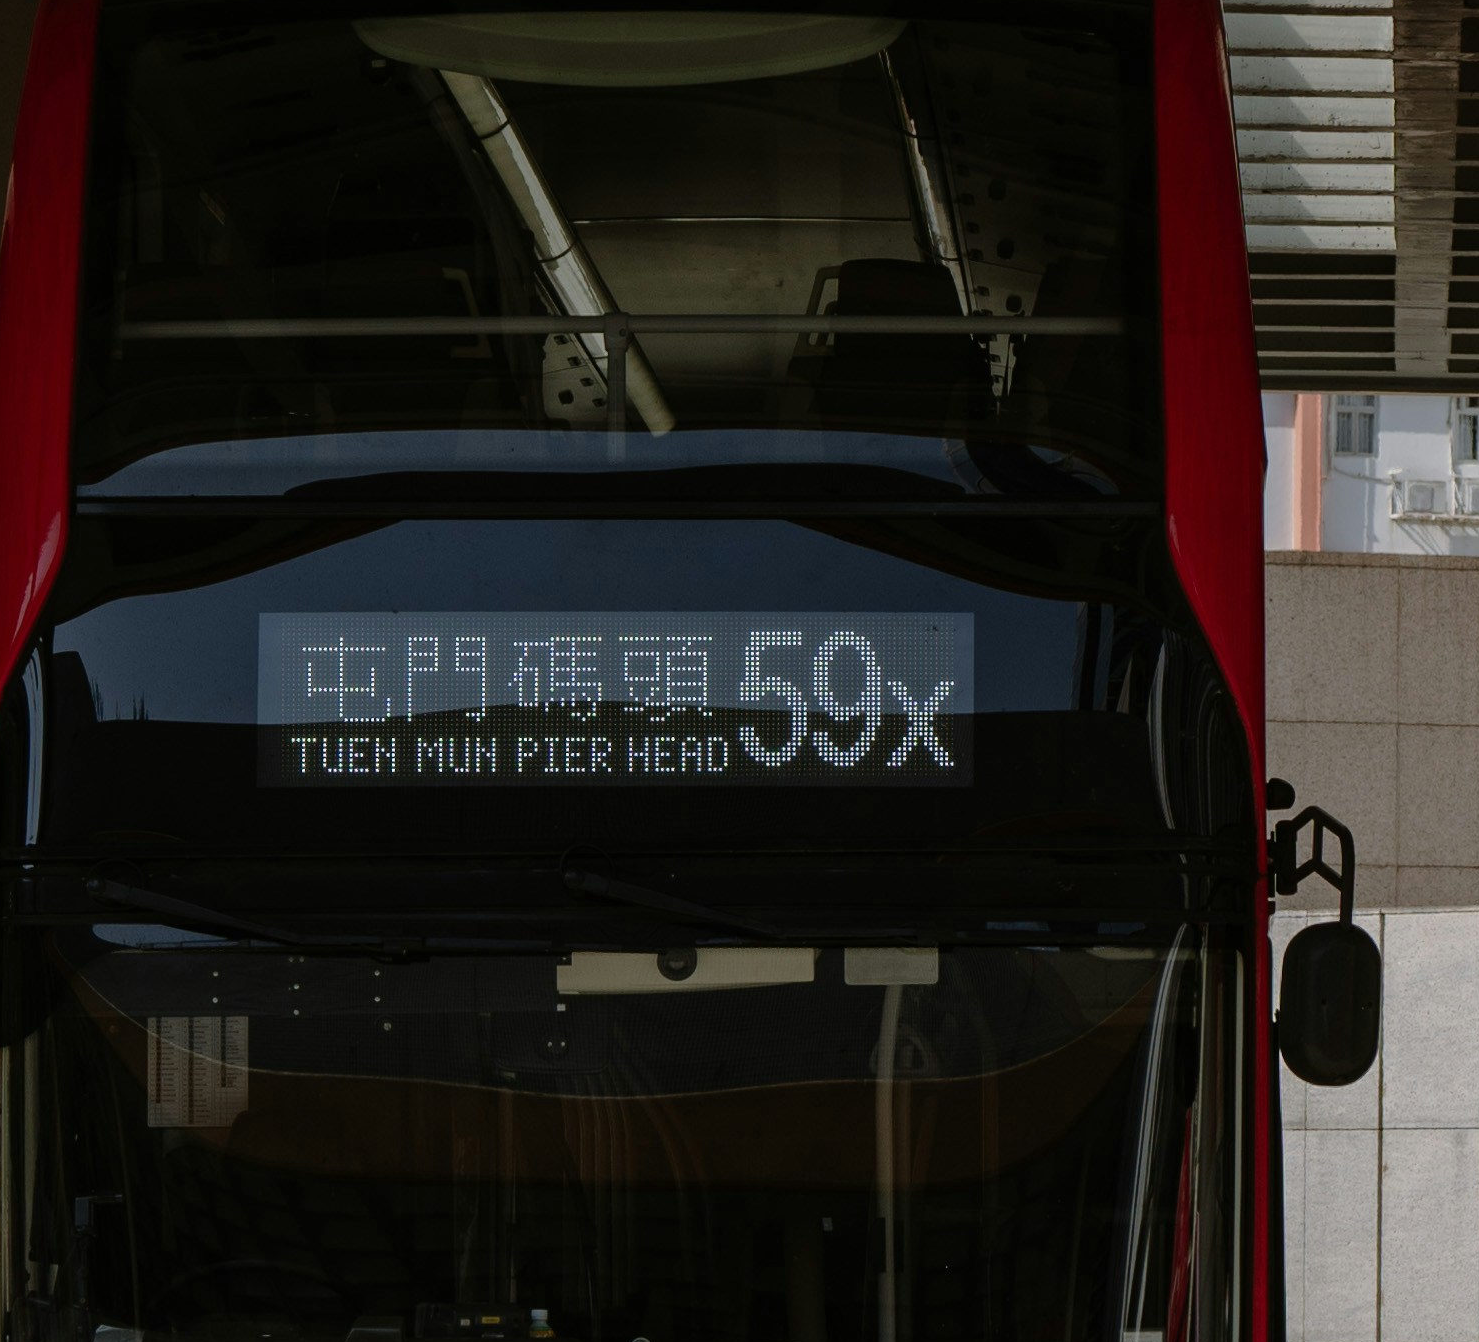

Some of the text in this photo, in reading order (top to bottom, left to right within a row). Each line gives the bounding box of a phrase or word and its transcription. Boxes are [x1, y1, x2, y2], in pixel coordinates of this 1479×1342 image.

[301, 635, 714, 722] 屯門碼頭
[291, 737, 728, 773] TUEN MUN PIER HEAD
